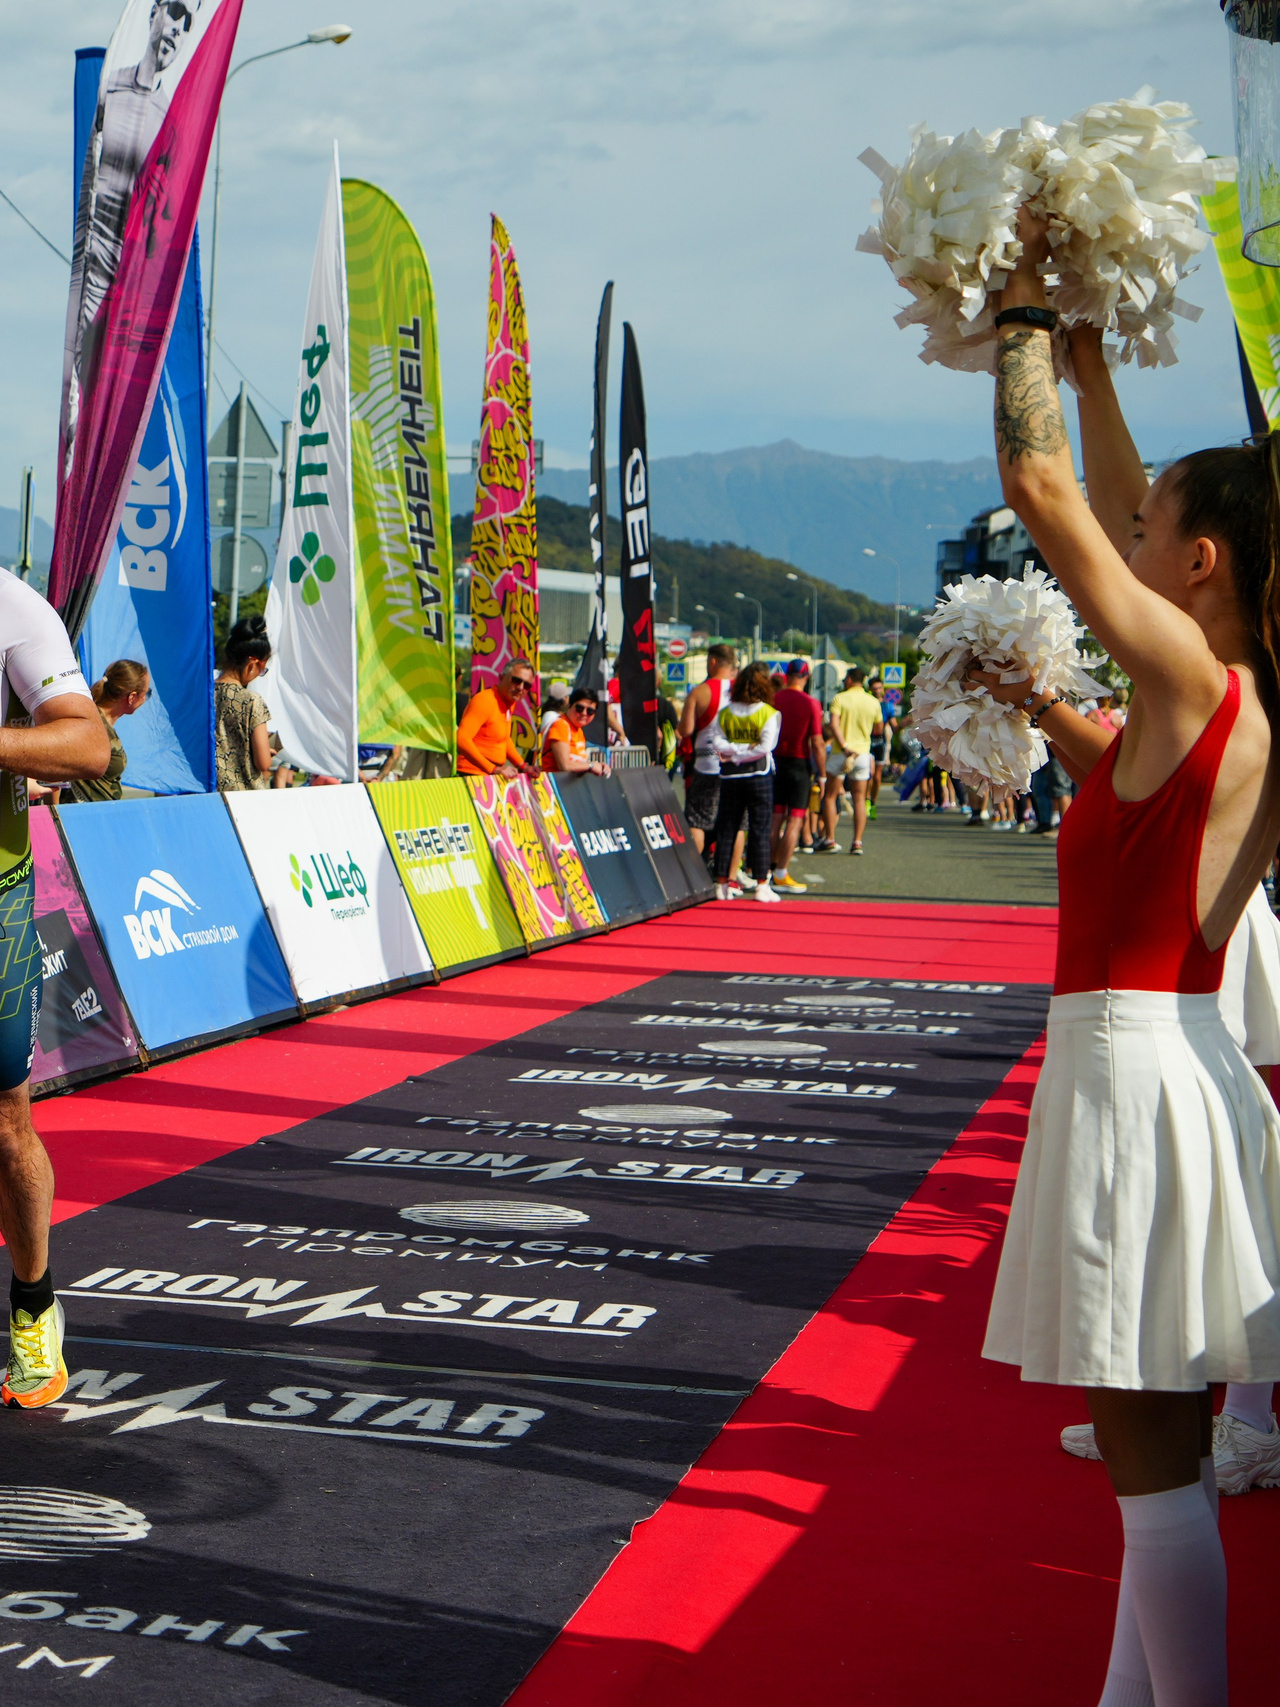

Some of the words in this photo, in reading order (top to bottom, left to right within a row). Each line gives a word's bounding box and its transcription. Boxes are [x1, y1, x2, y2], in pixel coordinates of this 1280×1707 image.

[393, 823, 475, 862] FAHRENHEIT
[641, 813, 686, 850] GEL4U
[310, 850, 370, 908] Шеф
[183, 925, 222, 948] СТРАХОВОЙ
[220, 925, 239, 943] ДОМ
[71, 987, 102, 1022] TELE2
[638, 1014, 763, 1026] IRON
[819, 1022, 960, 1034] STAR
[518, 1068, 668, 1085] IRON
[736, 1078, 898, 1096] STAR
[415, 1116, 839, 1146] Газпромбанк
[344, 1147, 529, 1169] IRON
[607, 1161, 805, 1185] STAR
[186, 1218, 715, 1265] Газпромбанк
[242, 1236, 611, 1271] Премиум
[69, 1267, 308, 1301] IRON
[402, 1290, 658, 1330] STAR
[247, 1386, 546, 1438] STAR
